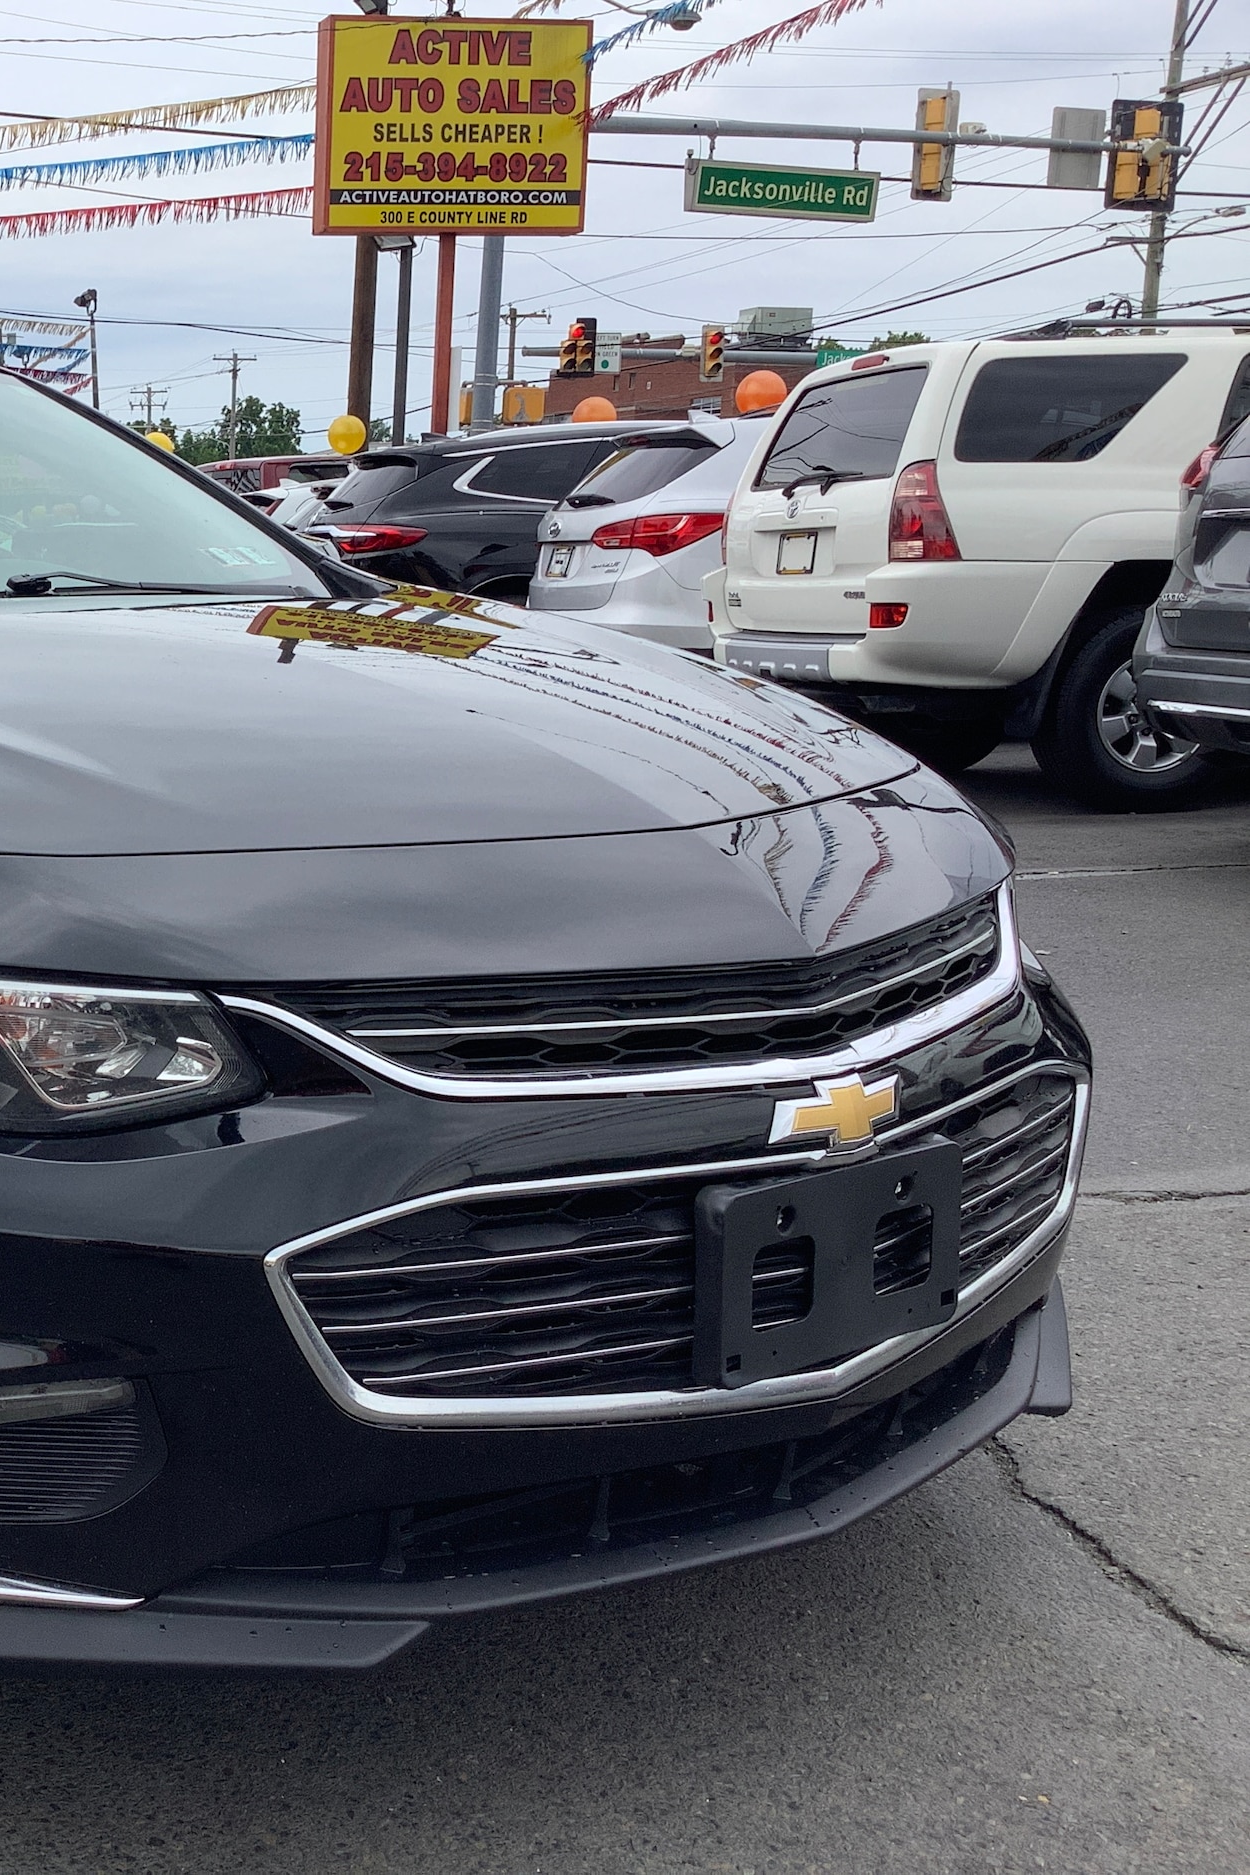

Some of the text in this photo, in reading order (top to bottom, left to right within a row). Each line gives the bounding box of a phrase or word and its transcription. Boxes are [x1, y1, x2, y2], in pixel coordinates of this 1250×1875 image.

[388, 29, 532, 66] ACTIVE
[339, 77, 576, 114] AUTO SALES
[373, 123, 433, 143] SELLS
[441, 124, 531, 143] CHEAPER
[343, 151, 568, 183] 215-394-8922
[339, 190, 568, 204] ACTIVEAUTOHATBORO.COM
[703, 176, 869, 207] Jacksonville Rd
[380, 211, 528, 224] 300 E COUNTY LINE RD
